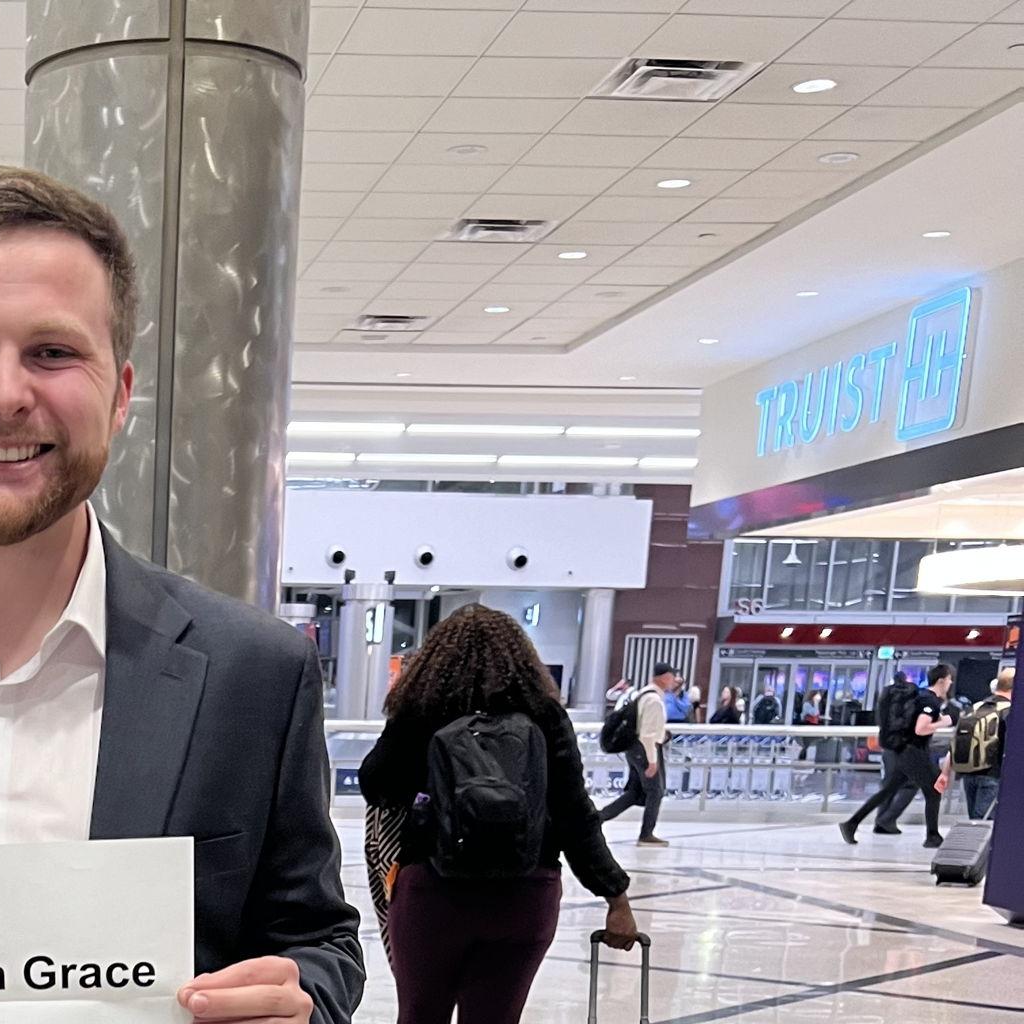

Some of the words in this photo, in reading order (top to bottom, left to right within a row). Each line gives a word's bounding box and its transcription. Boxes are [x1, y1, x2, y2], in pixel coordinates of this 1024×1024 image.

[755, 341, 897, 457] TRUIST
[734, 597, 763, 616] S6
[23, 955, 156, 990] Grace
